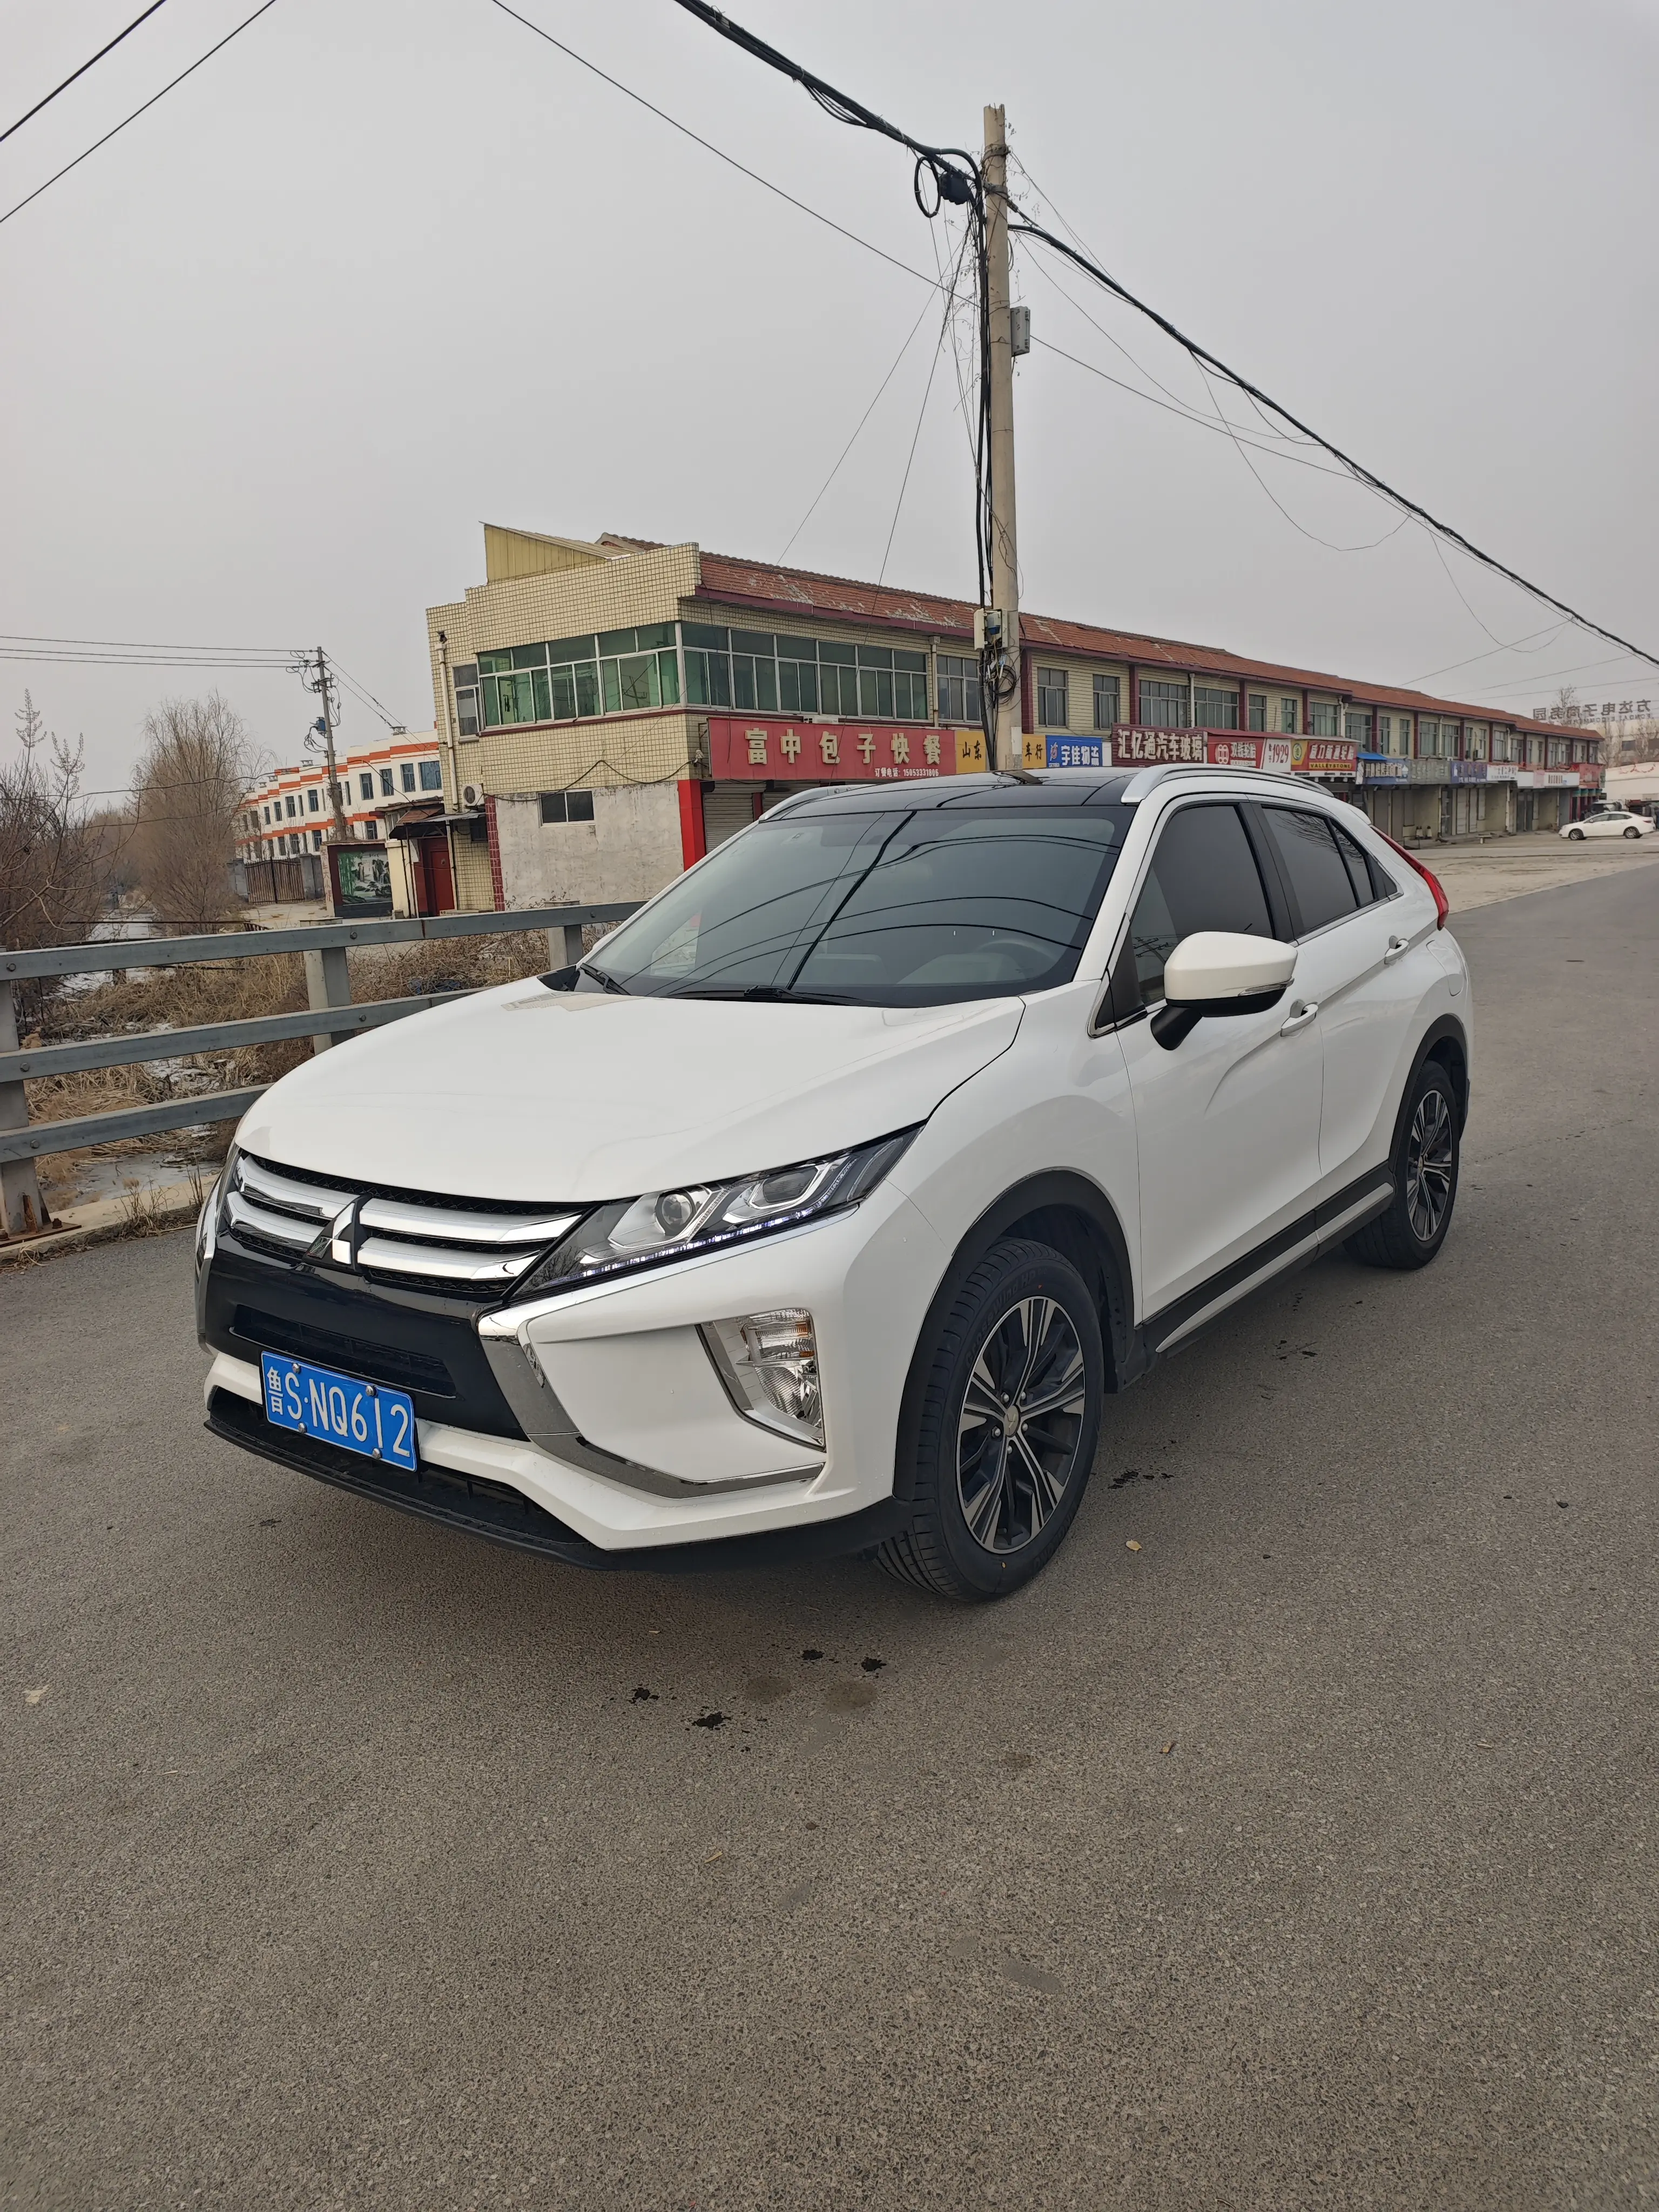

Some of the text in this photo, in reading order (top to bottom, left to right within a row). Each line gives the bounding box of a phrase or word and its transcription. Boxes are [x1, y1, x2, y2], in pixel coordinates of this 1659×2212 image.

[745, 727, 941, 765] 富中包子快餐
[962, 740, 982, 760] 山东
[1061, 745, 1100, 766] 宇佳物流
[1117, 729, 1202, 761] 汇亿通汽车玻璃
[1272, 744, 1289, 763] 1929
[902, 768, 939, 777] 15053331806
[267, 1366, 410, 1458] 鲁S·NQ612
